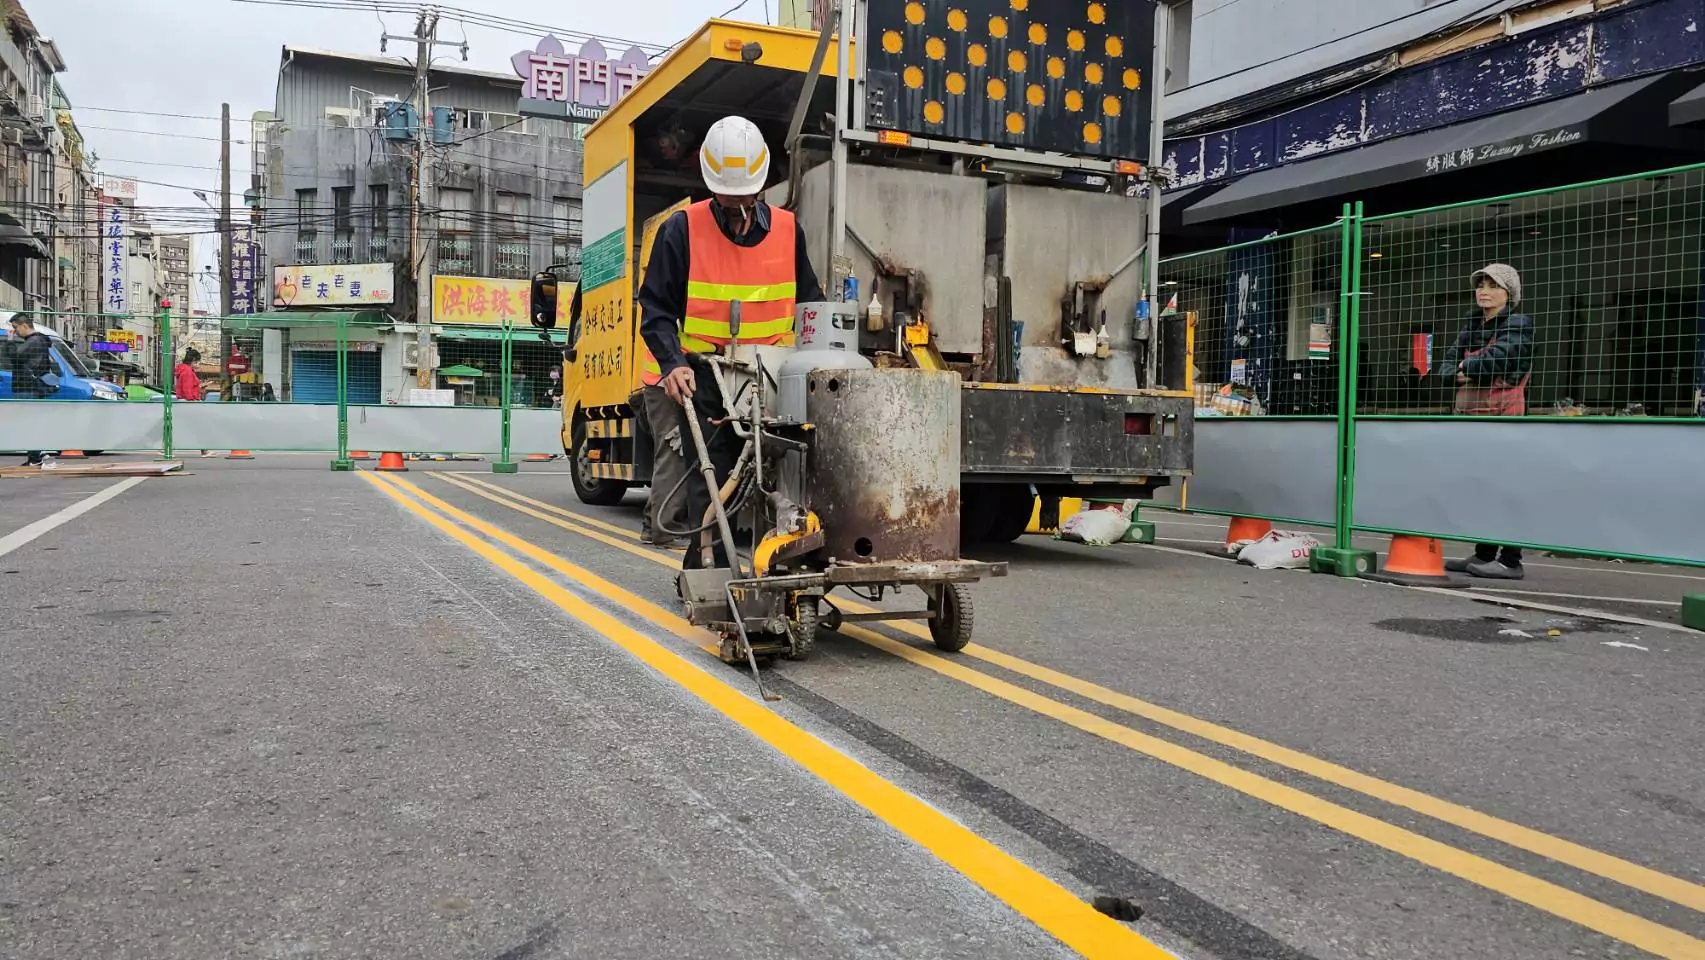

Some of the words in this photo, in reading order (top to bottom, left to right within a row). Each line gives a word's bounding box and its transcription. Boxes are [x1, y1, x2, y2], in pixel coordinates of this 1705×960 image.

[1477, 144, 1524, 160] Luxury
[1528, 129, 1581, 149] Fashion
[302, 274, 361, 298] 老夫老妻
